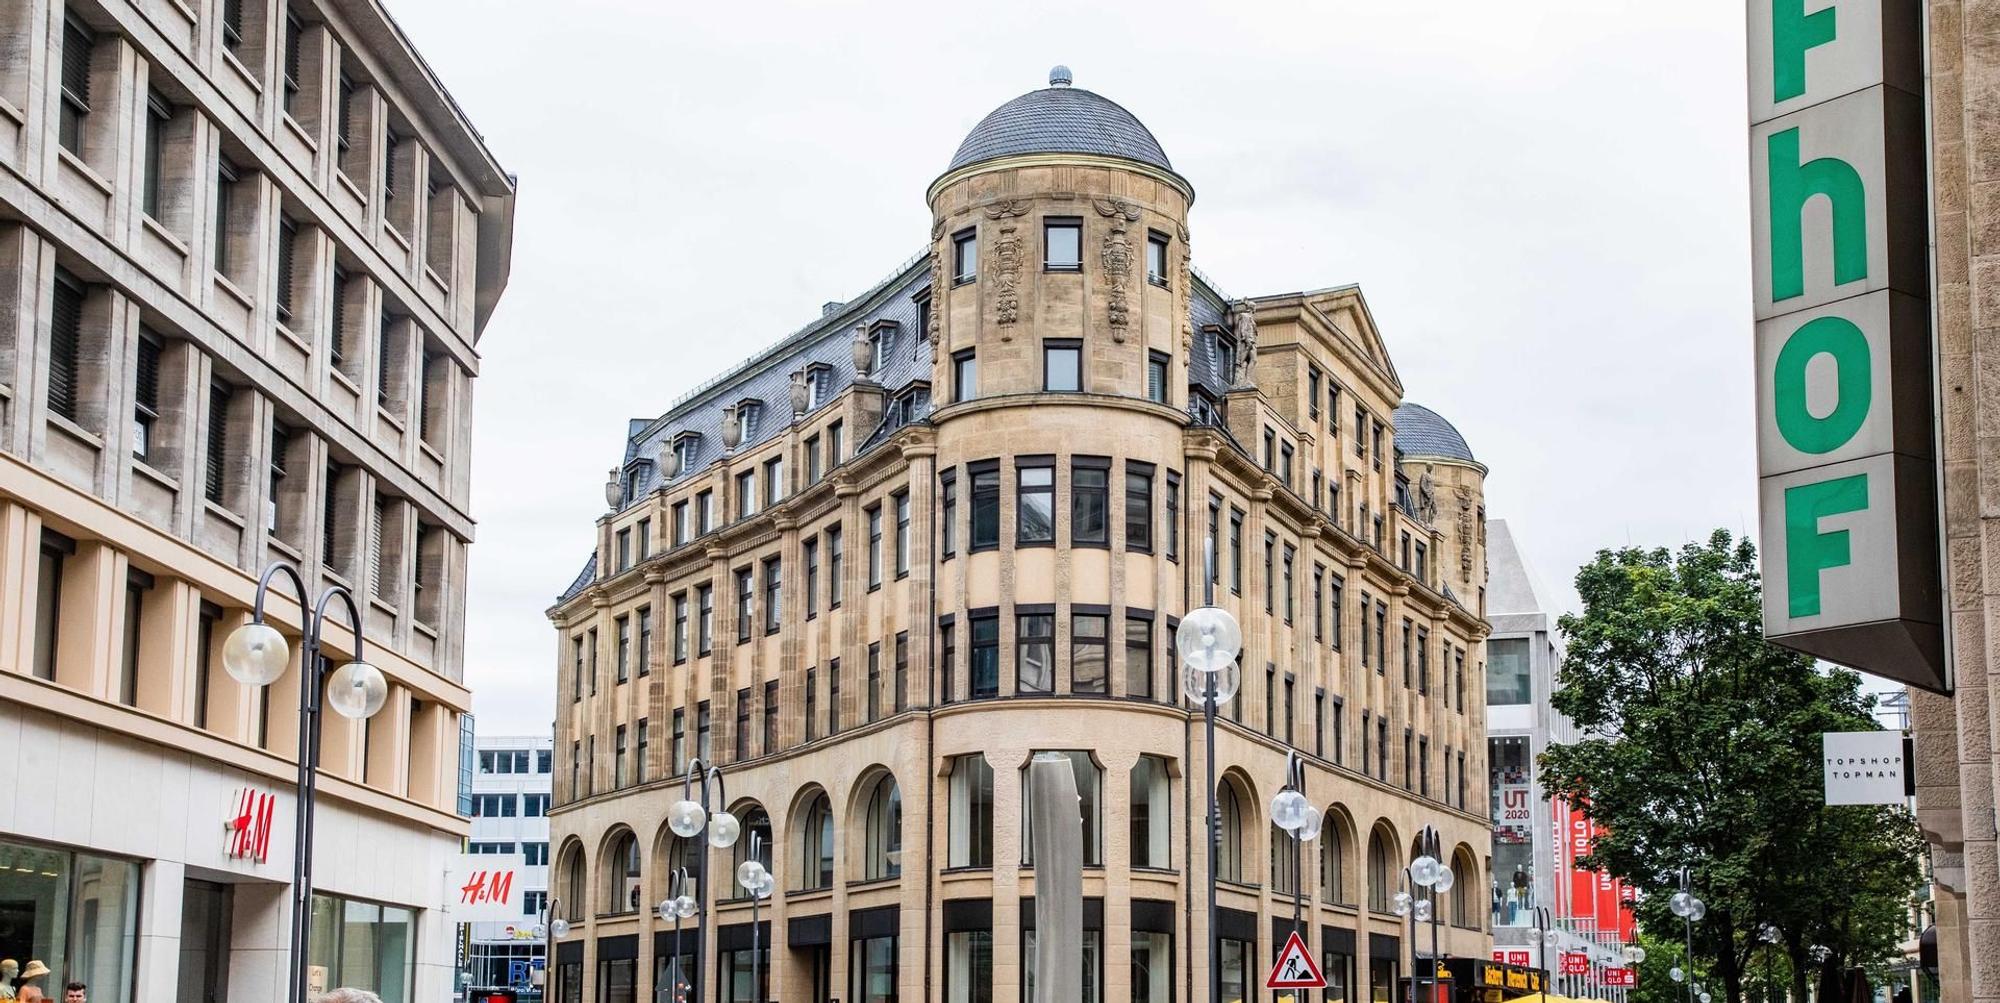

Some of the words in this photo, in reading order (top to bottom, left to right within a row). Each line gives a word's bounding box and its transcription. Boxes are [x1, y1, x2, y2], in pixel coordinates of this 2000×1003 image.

[1827, 757, 1901, 765] TOPSHOP
[1833, 771, 1897, 779] TOPMAN
[1504, 790, 1528, 808] UT
[1505, 810, 1529, 819] 2020
[226, 787, 275, 865] H&M
[461, 871, 513, 905] H&M
[1510, 953, 1526, 961] UNI
[1568, 956, 1584, 964] UNI
[1568, 964, 1585, 972] QLO
